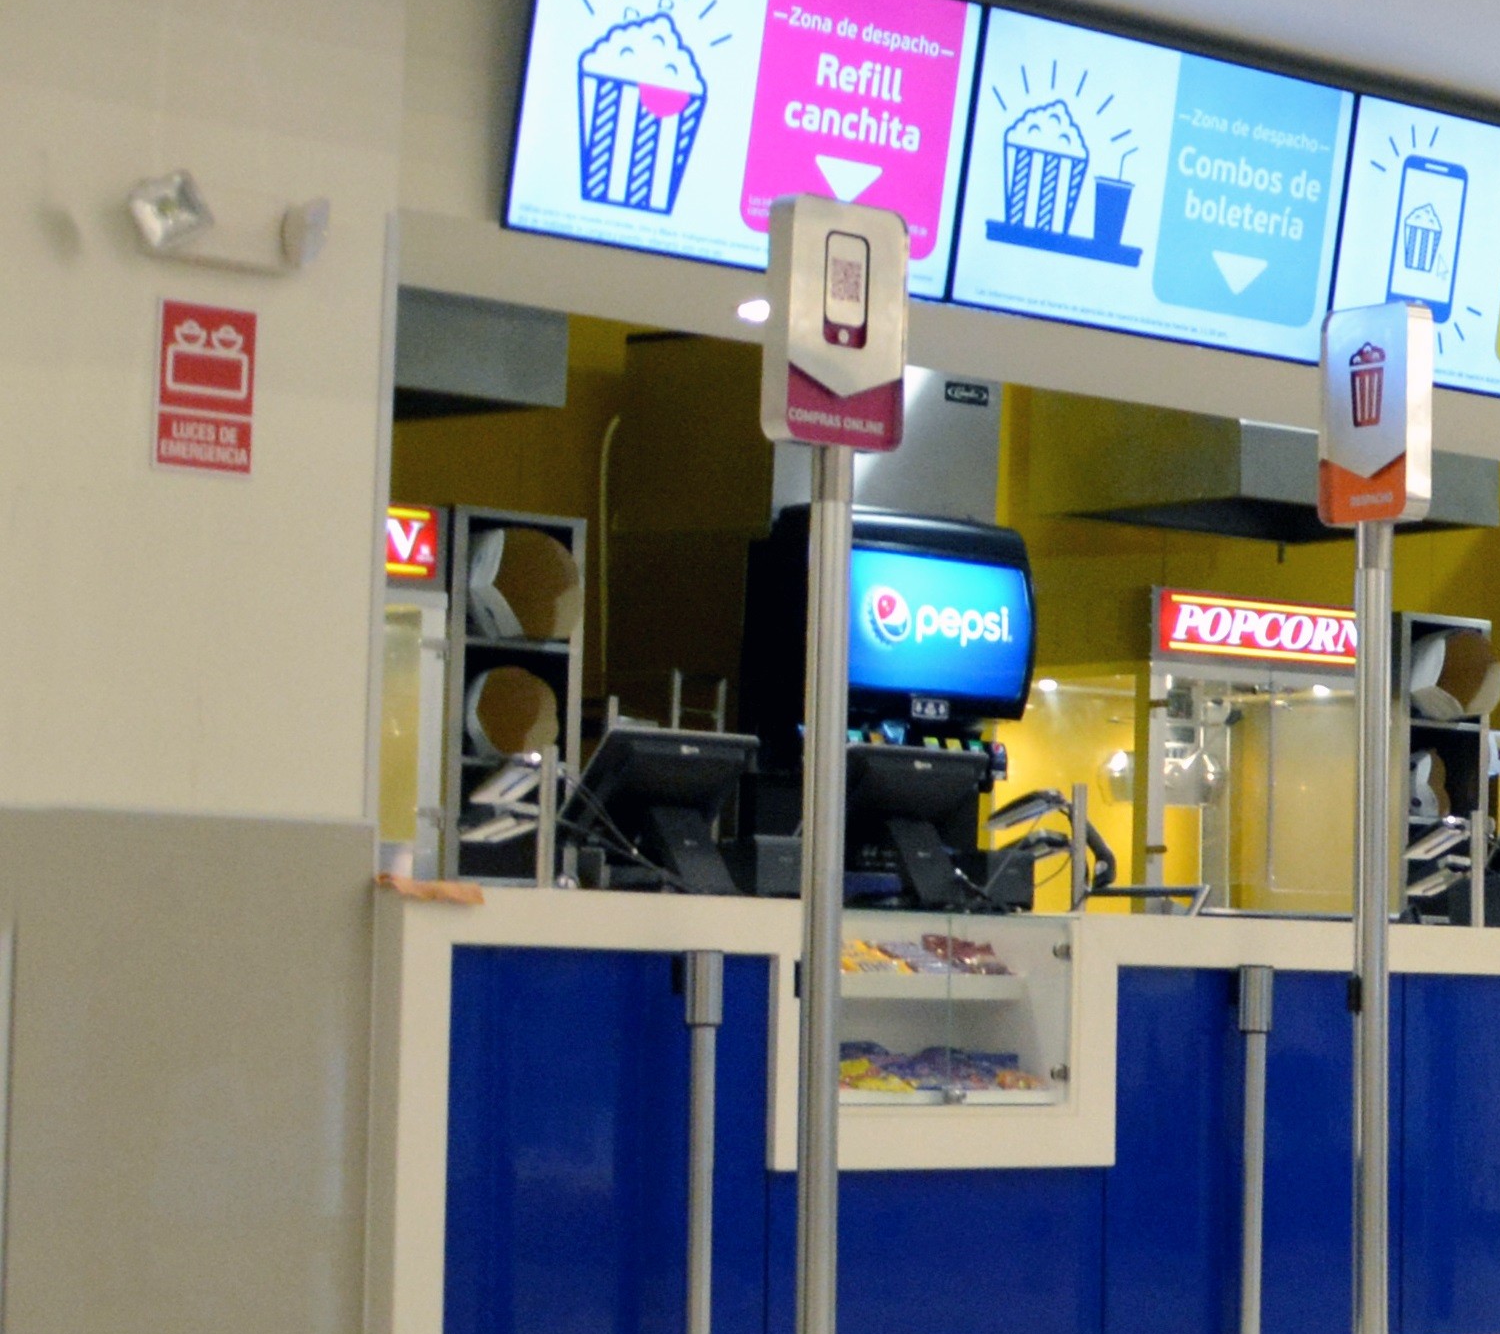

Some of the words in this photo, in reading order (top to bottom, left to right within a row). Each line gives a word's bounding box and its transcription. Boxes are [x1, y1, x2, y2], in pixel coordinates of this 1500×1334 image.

[789, 5, 832, 33] Zona
[837, 18, 858, 39] de
[862, 23, 939, 57] despacho
[816, 52, 902, 102] Refill
[784, 100, 921, 152] canchita
[1191, 108, 1228, 132] Zona
[1232, 119, 1250, 137] de
[1253, 123, 1318, 153] despacho
[1178, 145, 1283, 194] Combos
[1289, 170, 1322, 202] de
[1184, 188, 1304, 240] boletería
[172, 419, 217, 442] LUCES
[219, 425, 238, 444] DE
[787, 407, 842, 430] COMPRAS
[843, 416, 885, 436] ONLINE
[160, 438, 248, 465] EMERGENCIA
[915, 604, 1010, 647] pepsi
[1172, 603, 1358, 653] POPCORN
